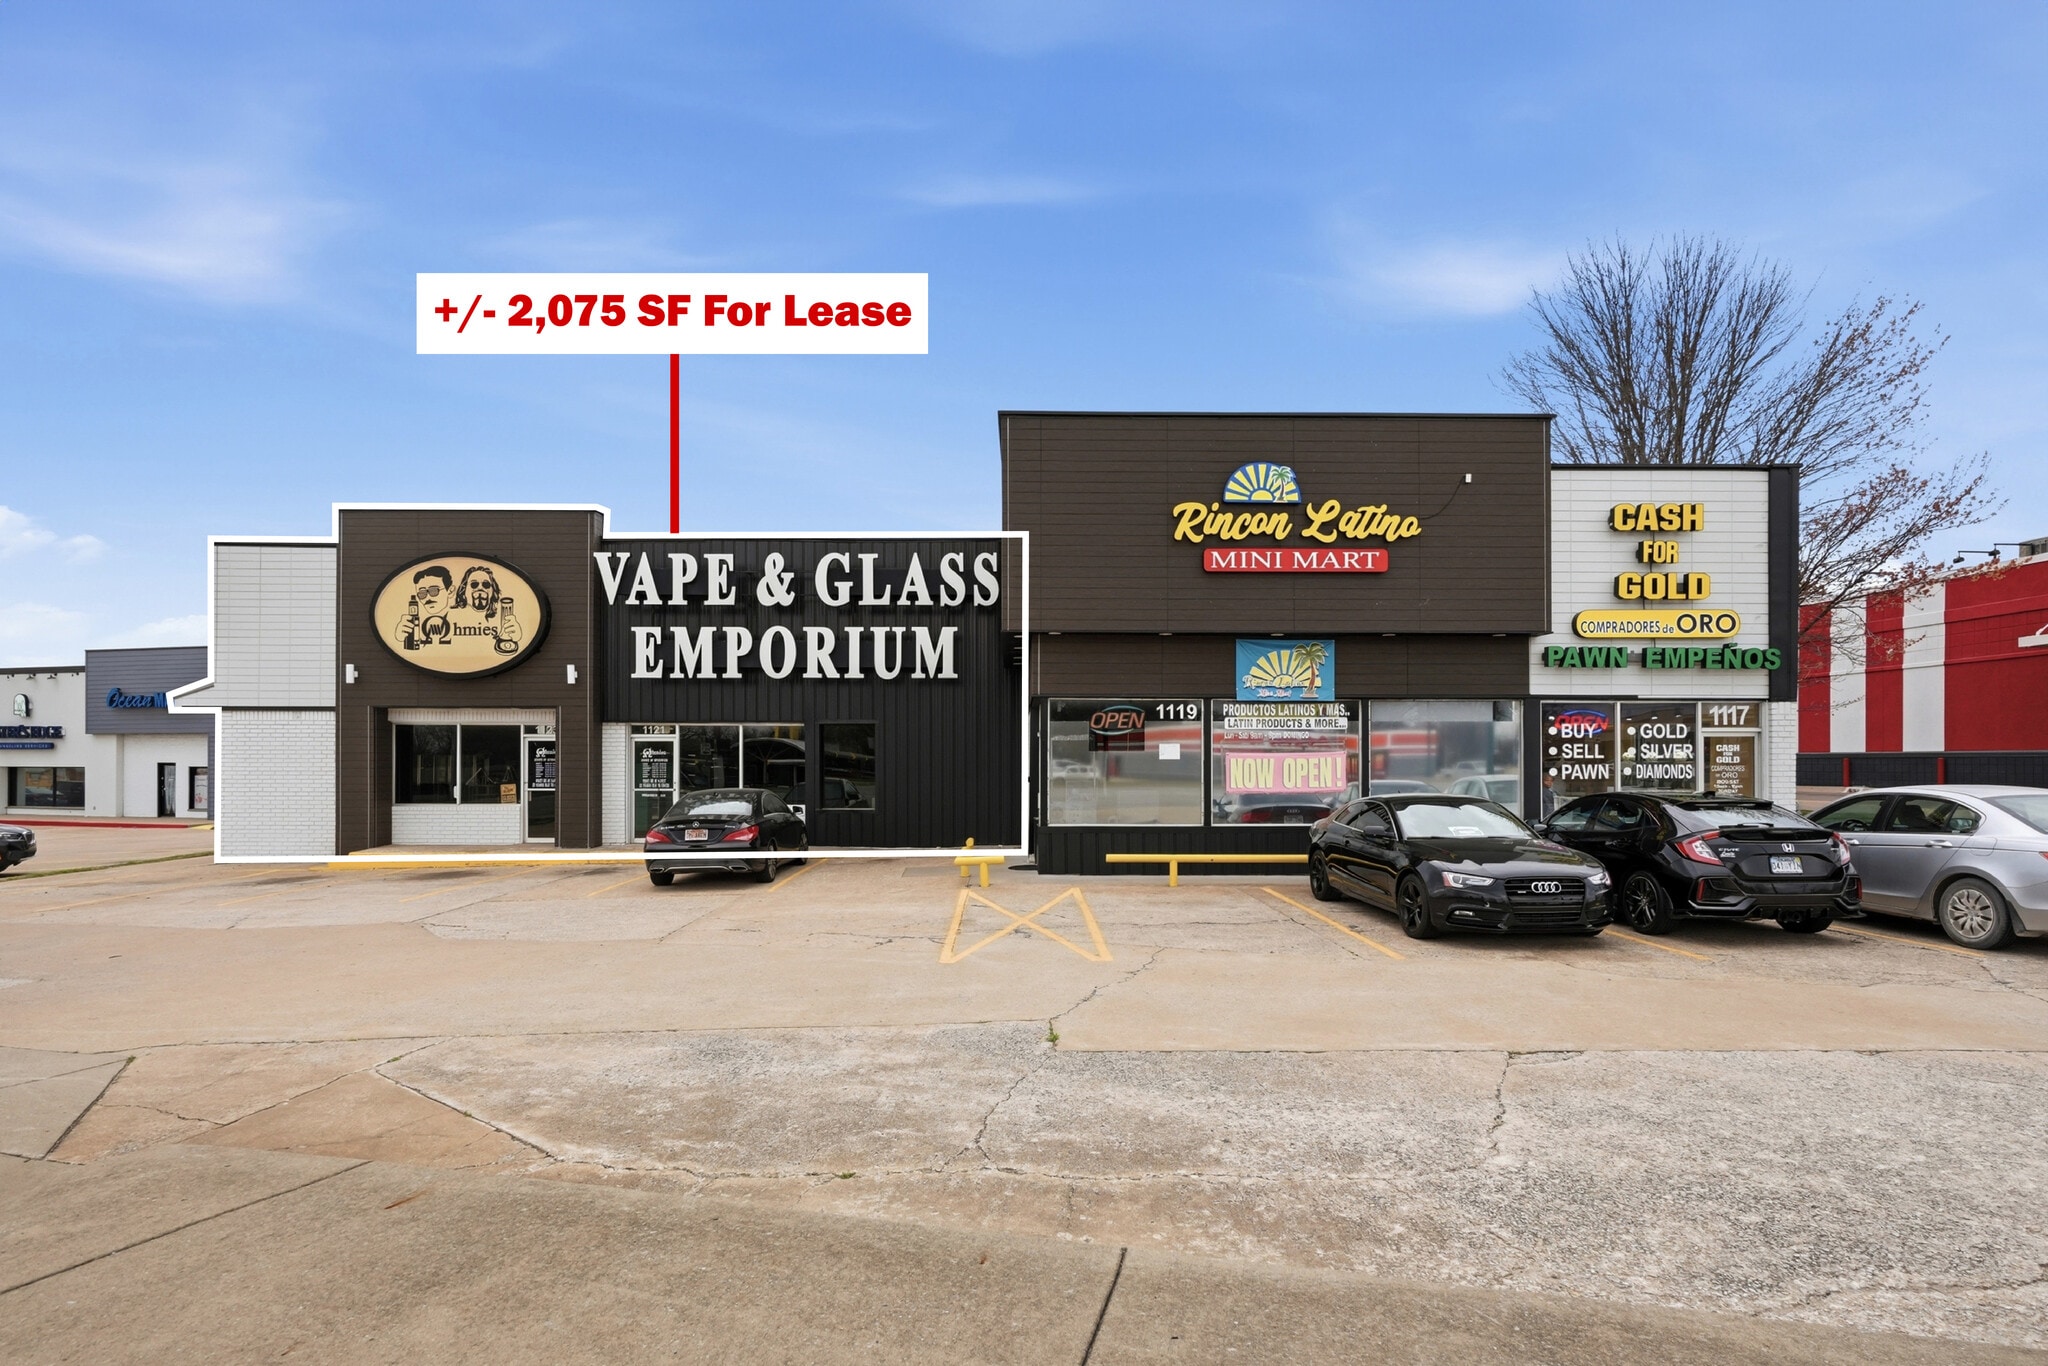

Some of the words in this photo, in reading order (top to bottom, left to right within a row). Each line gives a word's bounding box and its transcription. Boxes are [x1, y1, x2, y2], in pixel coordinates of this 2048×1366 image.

[1172, 502, 1293, 543] Rincon
[1301, 499, 1422, 543] Latino
[1612, 503, 1704, 531] CASH
[1211, 551, 1283, 568] MINI
[1292, 551, 1380, 569] MART
[1642, 540, 1679, 563] FOR
[594, 551, 736, 606] VAPE
[756, 551, 796, 607] &
[815, 551, 1000, 607] GLASS
[1617, 572, 1711, 600] GOLD
[1580, 620, 1660, 634] COMPRADORES
[1662, 624, 1675, 634] de
[1676, 613, 1737, 634] ORO
[630, 625, 959, 680] EMPORIUM
[1547, 646, 1628, 668] PAWN
[1645, 642, 1782, 670] EMPEÑOS
[106, 687, 152, 708] Ocean
[1156, 703, 1198, 719] 1119
[1223, 704, 1276, 716] PRODUCTOS
[1278, 704, 1315, 716] LATINOS
[1317, 704, 1325, 716] Y
[1709, 705, 1750, 726] 1117
[1090, 712, 1145, 729] OPEN
[1228, 719, 1253, 728] LATIN
[1255, 719, 1303, 728] PRODUCTS
[1305, 719, 1311, 728] &
[642, 725, 665, 734] 1121
[1561, 723, 1597, 738] BUY
[1640, 723, 1688, 739] GOLD
[1562, 743, 1605, 759] SELL
[1640, 743, 1694, 759] SILVER
[1716, 744, 1740, 752] CASH
[1716, 756, 1740, 764] GOLD
[1230, 757, 1275, 789] NOW
[1562, 764, 1609, 780] PAWN
[1636, 764, 1693, 779] DIAMONDS
